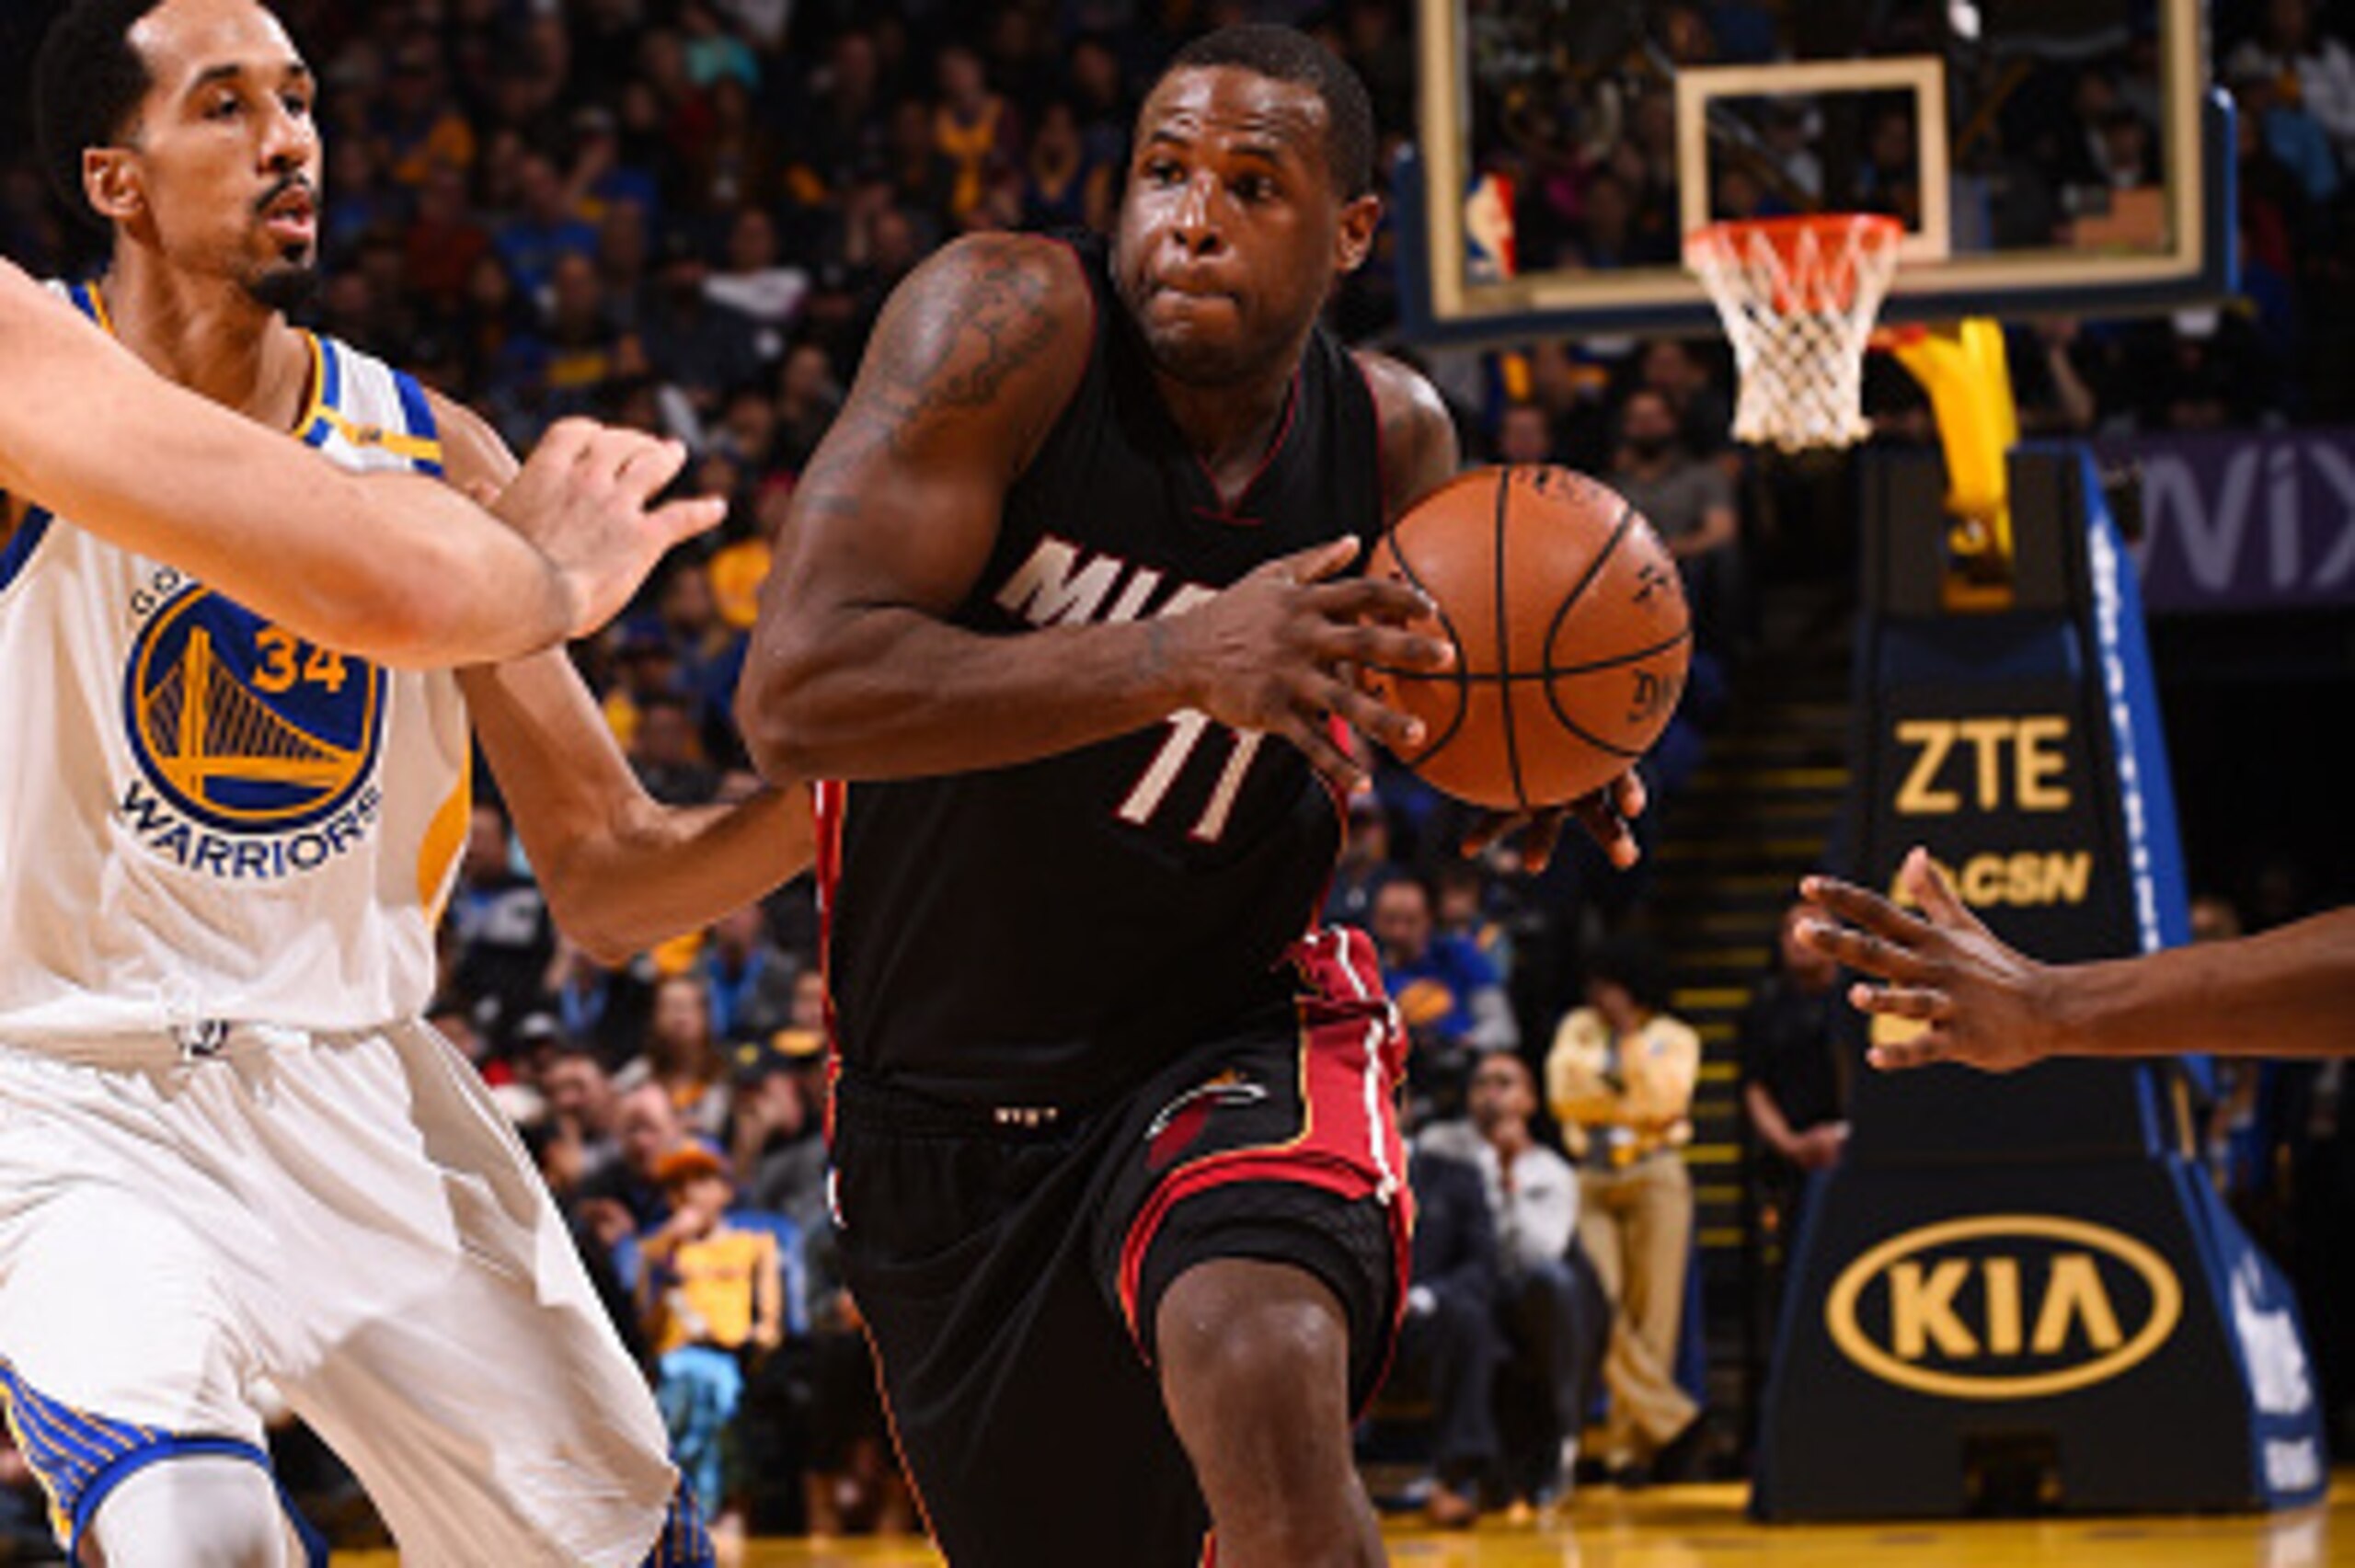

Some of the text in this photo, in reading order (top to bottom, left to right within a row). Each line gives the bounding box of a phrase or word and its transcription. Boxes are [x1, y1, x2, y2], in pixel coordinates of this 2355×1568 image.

[253, 626, 347, 692] 34
[1113, 706, 1266, 843] 11
[1895, 716, 2073, 812] ZTE
[121, 782, 382, 879] WARRIORS
[1961, 851, 2093, 908] CSN
[1888, 1252, 2125, 1359] KIA
